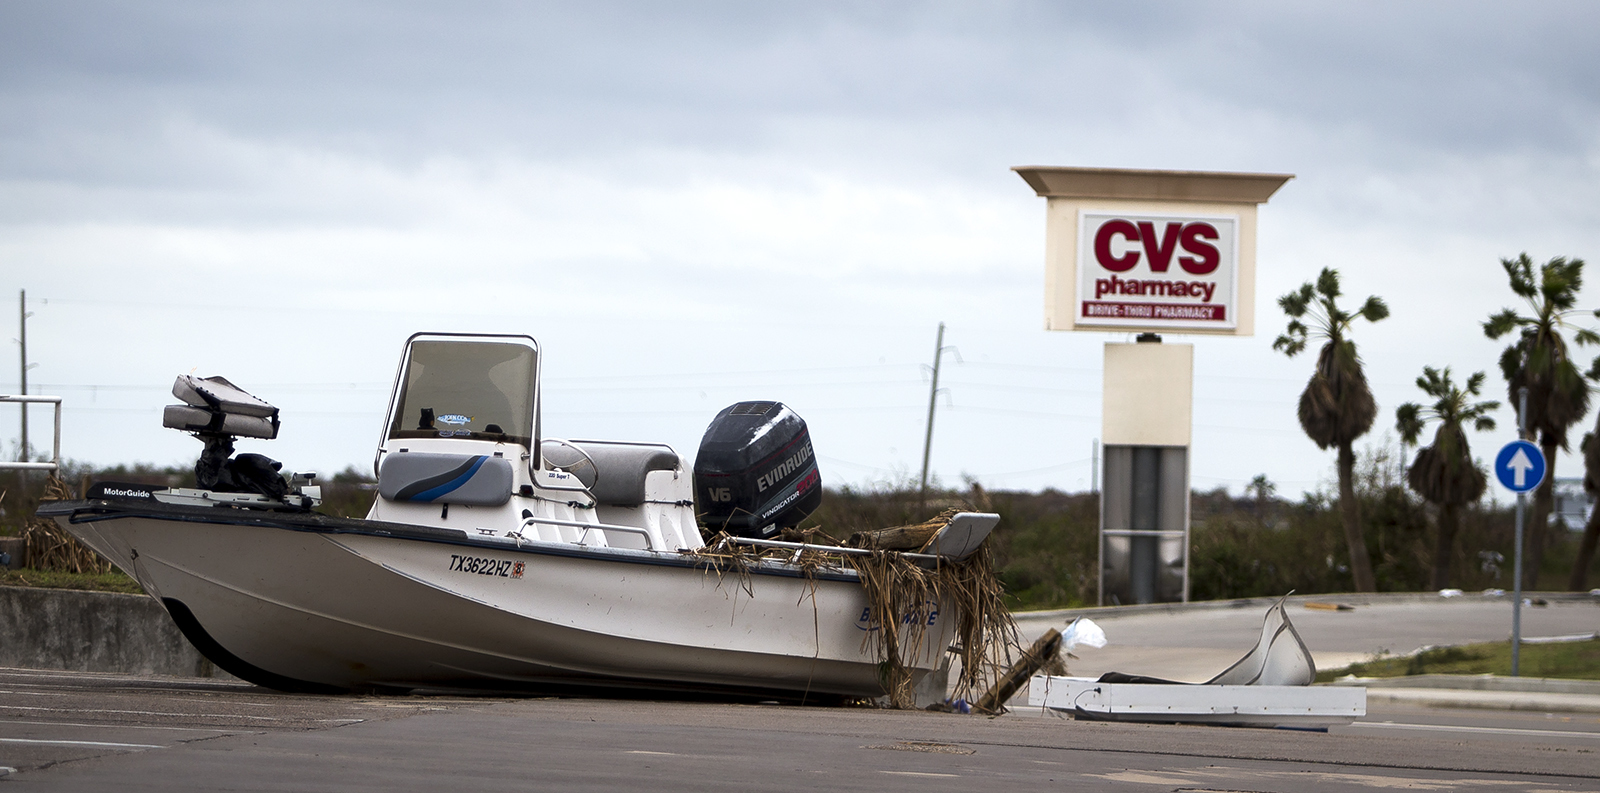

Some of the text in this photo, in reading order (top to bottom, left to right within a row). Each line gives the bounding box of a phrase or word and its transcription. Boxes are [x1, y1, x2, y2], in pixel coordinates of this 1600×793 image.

[1094, 218, 1220, 275] CVS
[1095, 274, 1216, 302] pharmacy
[1087, 305, 1214, 319] DRIVE-THRU PHARMACY
[757, 441, 812, 493] EVINRUDE
[103, 487, 150, 498] MotorGuide
[796, 468, 818, 494] 200
[708, 487, 732, 502] V6
[762, 490, 800, 518] VINDICATOR
[449, 554, 512, 577] TX3622HZ
